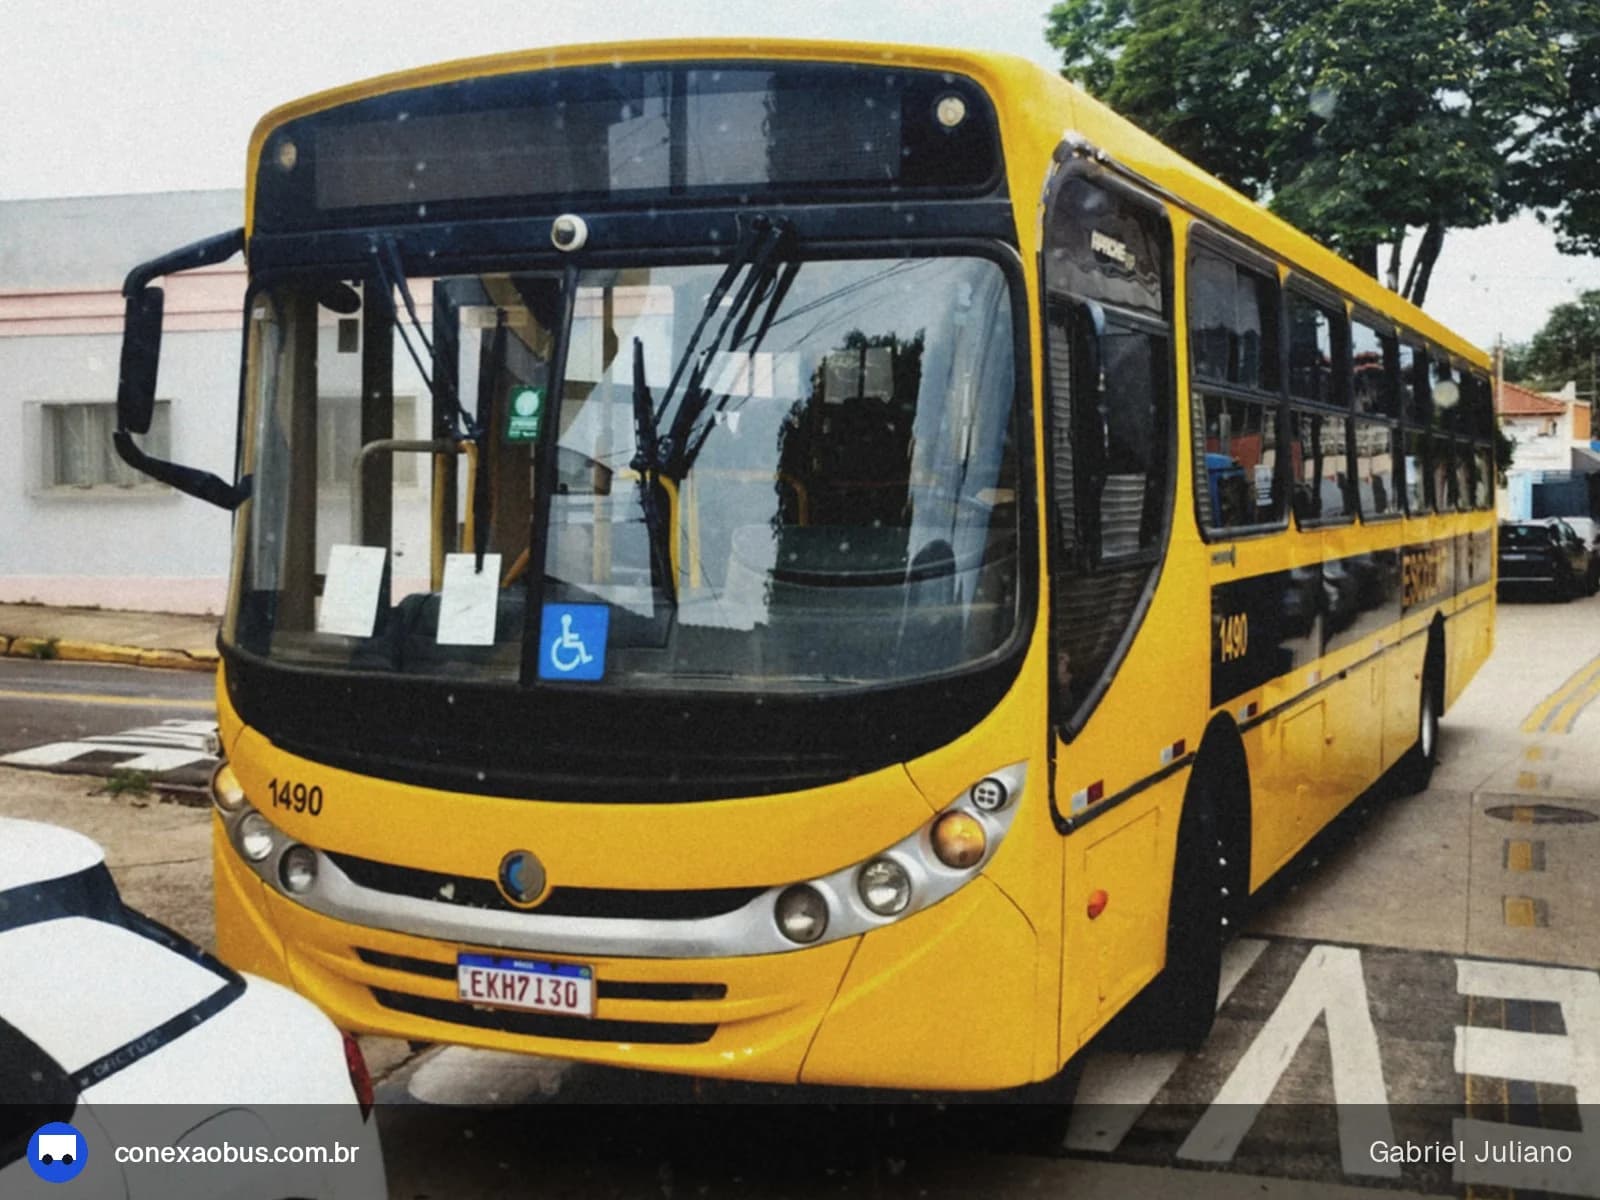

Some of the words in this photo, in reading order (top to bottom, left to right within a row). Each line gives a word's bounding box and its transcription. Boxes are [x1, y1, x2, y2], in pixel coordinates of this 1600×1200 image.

[1219, 612, 1248, 663] 1490
[267, 777, 323, 816] 1490
[470, 970, 578, 1008] EKH7130
